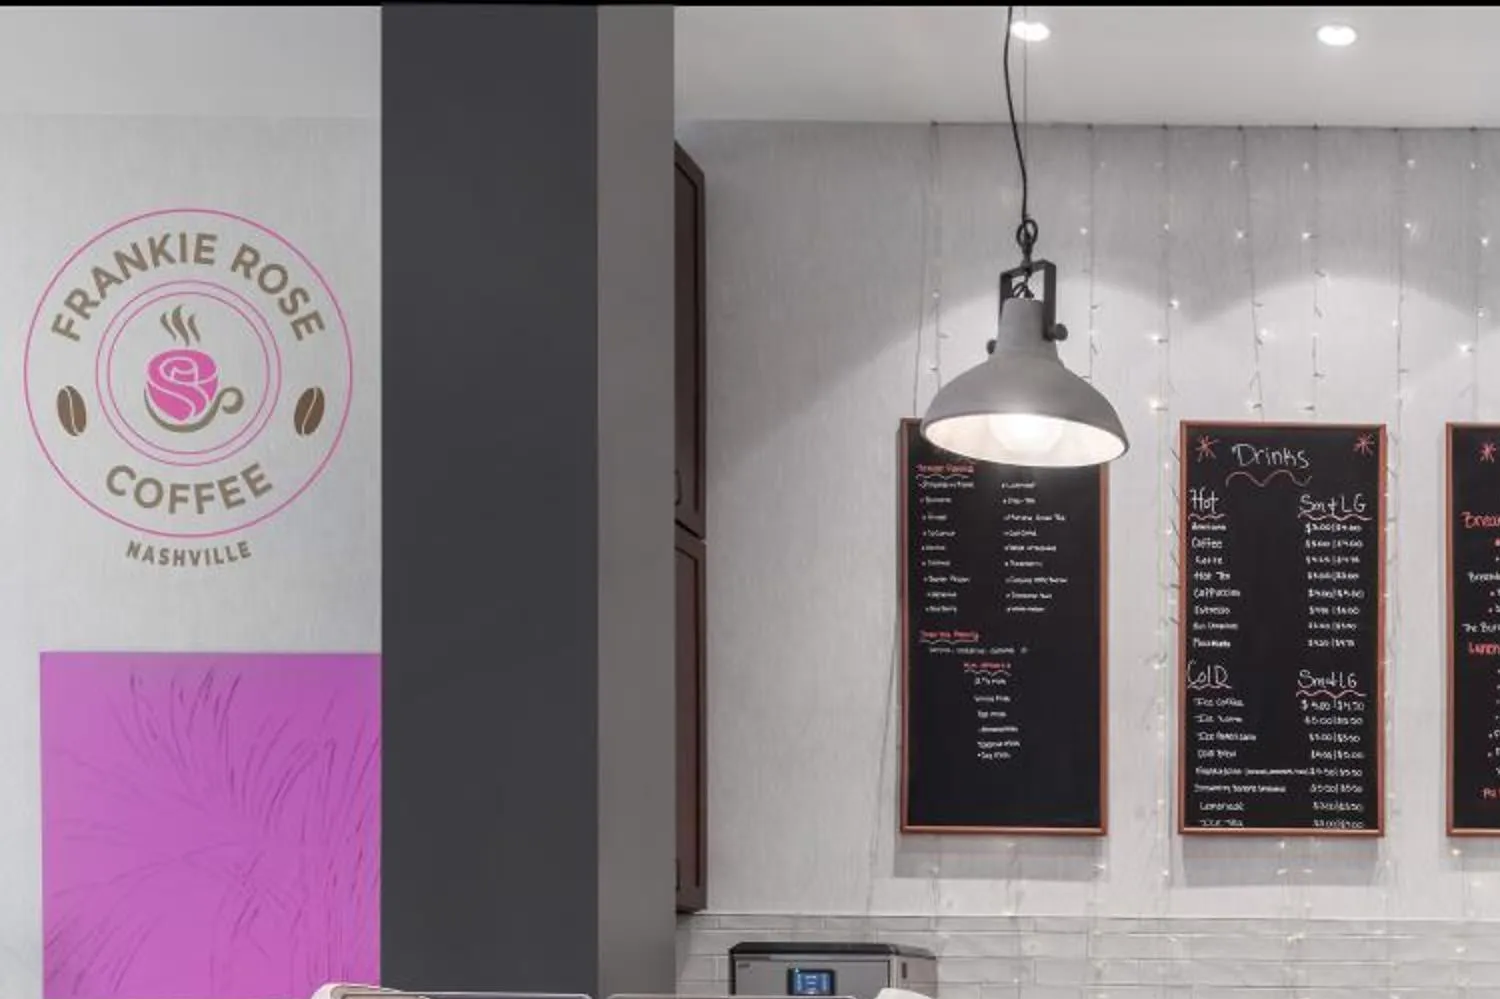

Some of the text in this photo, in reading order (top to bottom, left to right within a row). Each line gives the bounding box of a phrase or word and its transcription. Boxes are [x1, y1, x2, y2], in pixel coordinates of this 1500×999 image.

[51, 231, 326, 342] FRANKIE ROSE
[1232, 444, 1309, 468] Drinks
[106, 462, 273, 515] COFFEE
[1190, 487, 1219, 514] Hot
[126, 540, 252, 567] NASHVILLE
[1192, 537, 1223, 549] Coffee
